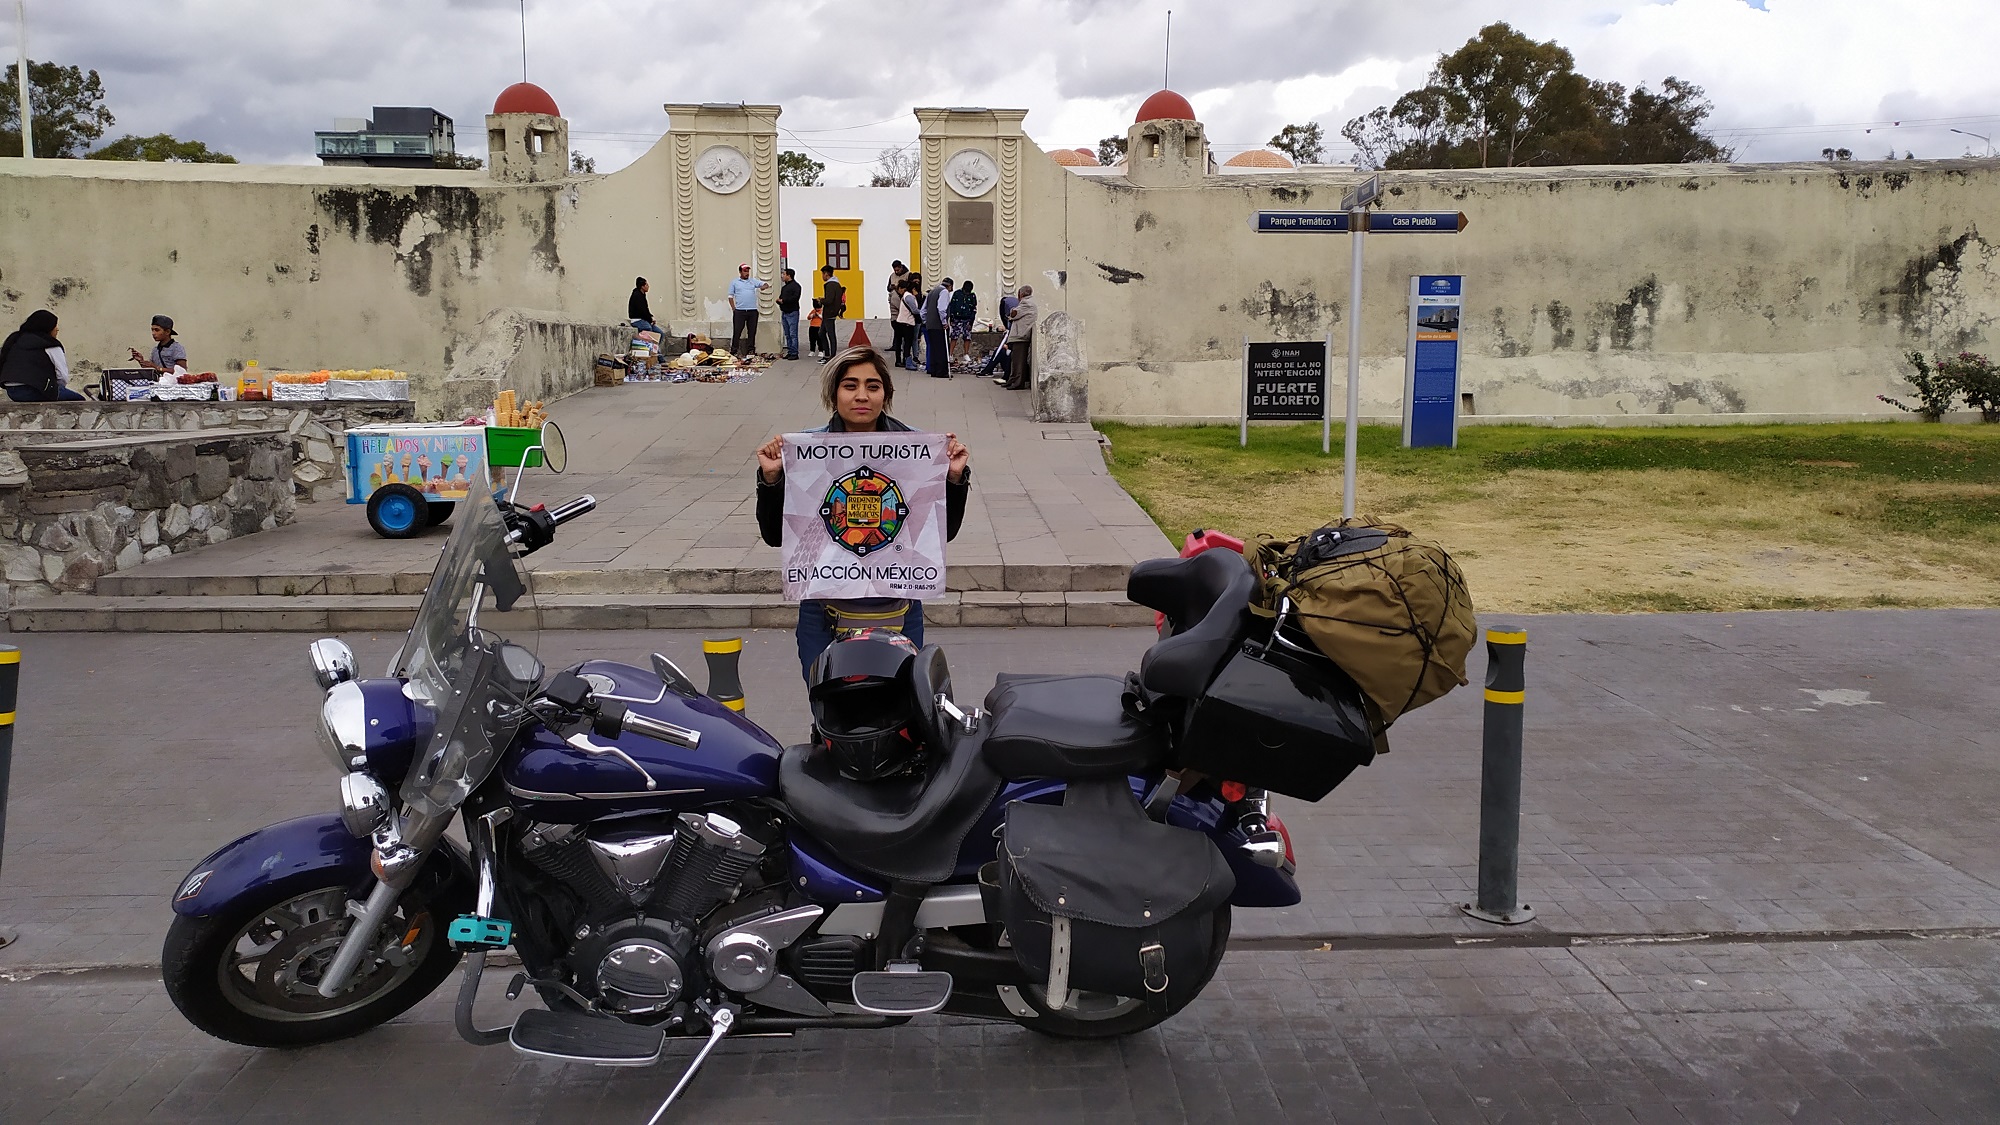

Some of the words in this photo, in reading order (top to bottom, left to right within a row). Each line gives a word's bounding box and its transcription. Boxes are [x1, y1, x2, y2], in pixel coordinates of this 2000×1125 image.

[1270, 217, 1297, 227] Parque
[1298, 216, 1332, 226] Temático
[1333, 217, 1337, 226] 1
[1393, 217, 1411, 226] Casa
[1412, 217, 1437, 226] Puebla
[1256, 383, 1317, 393] FUERTE
[1253, 395, 1269, 405] DE
[1272, 395, 1320, 405] LORETO
[362, 437, 419, 454] HELADOS
[422, 437, 431, 453] Y
[433, 435, 477, 453] NIEVES
[797, 445, 854, 460] MOTO
[859, 444, 931, 460] TURISTA
[788, 568, 808, 583] EN
[810, 563, 872, 581] ACCIÓN
[876, 563, 938, 581] MÉXICO
